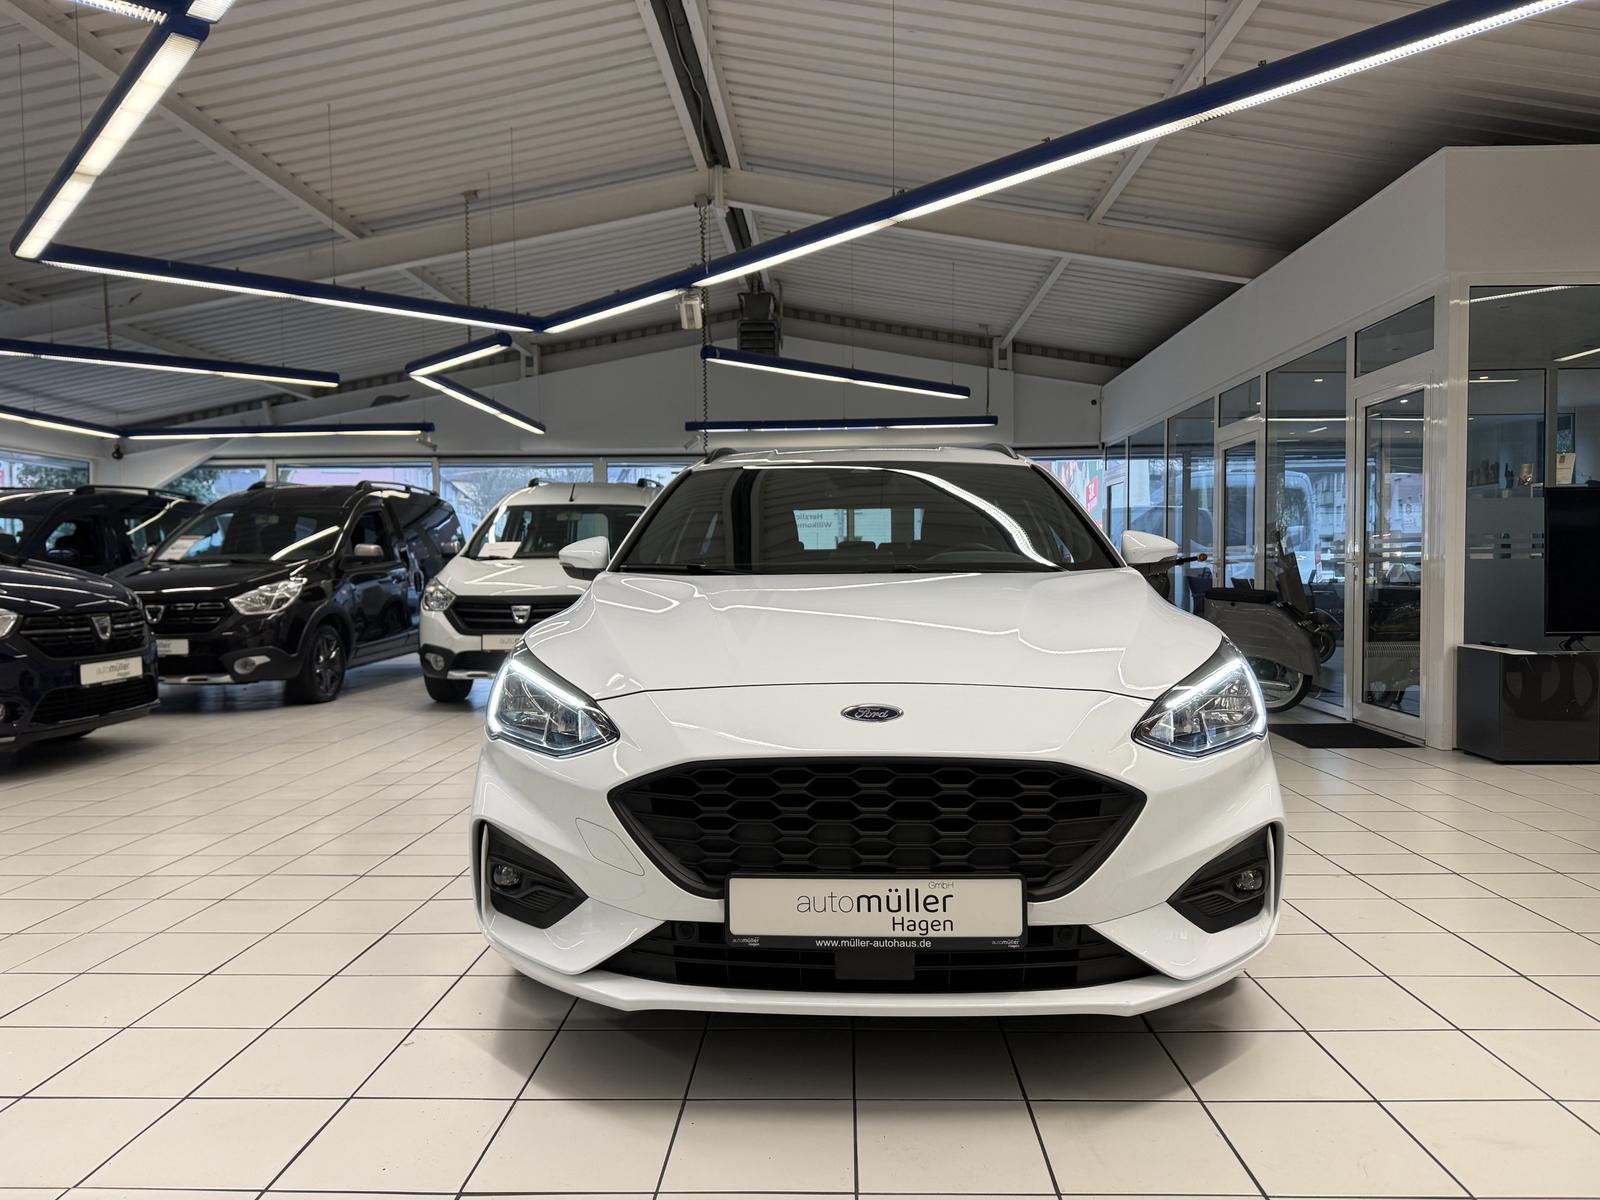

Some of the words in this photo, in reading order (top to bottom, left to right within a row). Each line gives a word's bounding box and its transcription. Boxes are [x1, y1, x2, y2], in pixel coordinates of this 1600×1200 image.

[854, 706, 889, 719] Ford
[928, 881, 954, 889] GmbH
[797, 888, 954, 913] automüller
[892, 916, 954, 936] Hagen
[815, 938, 932, 948] www.müller-autohaus.de
